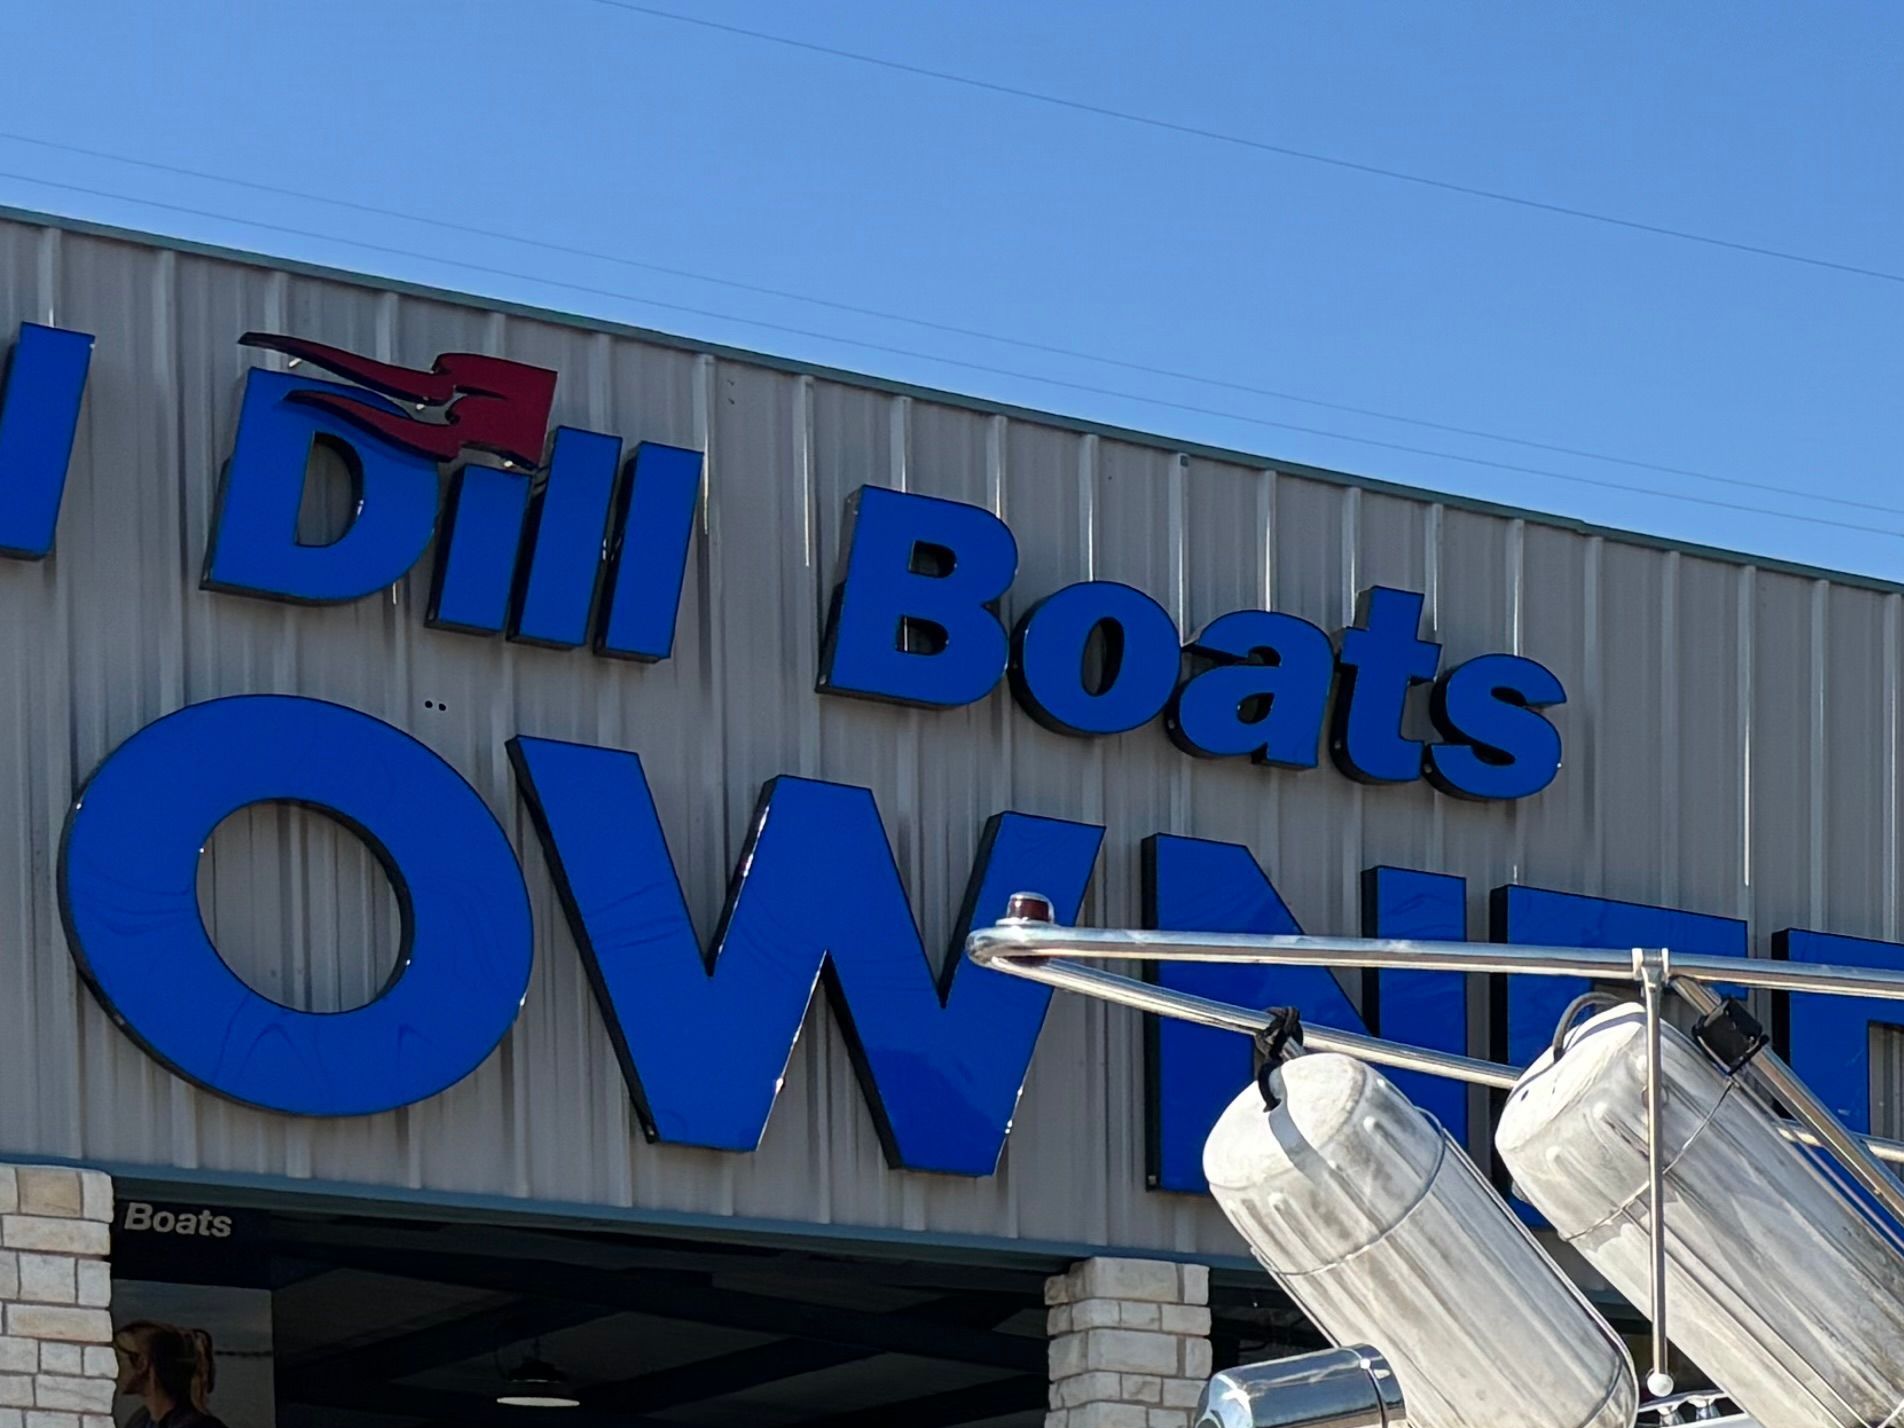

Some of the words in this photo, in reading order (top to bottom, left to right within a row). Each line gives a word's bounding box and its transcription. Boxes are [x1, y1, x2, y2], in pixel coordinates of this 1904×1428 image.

[200, 364, 705, 664] Dill
[815, 483, 1568, 801] Boats
[123, 1201, 233, 1238] Boats
